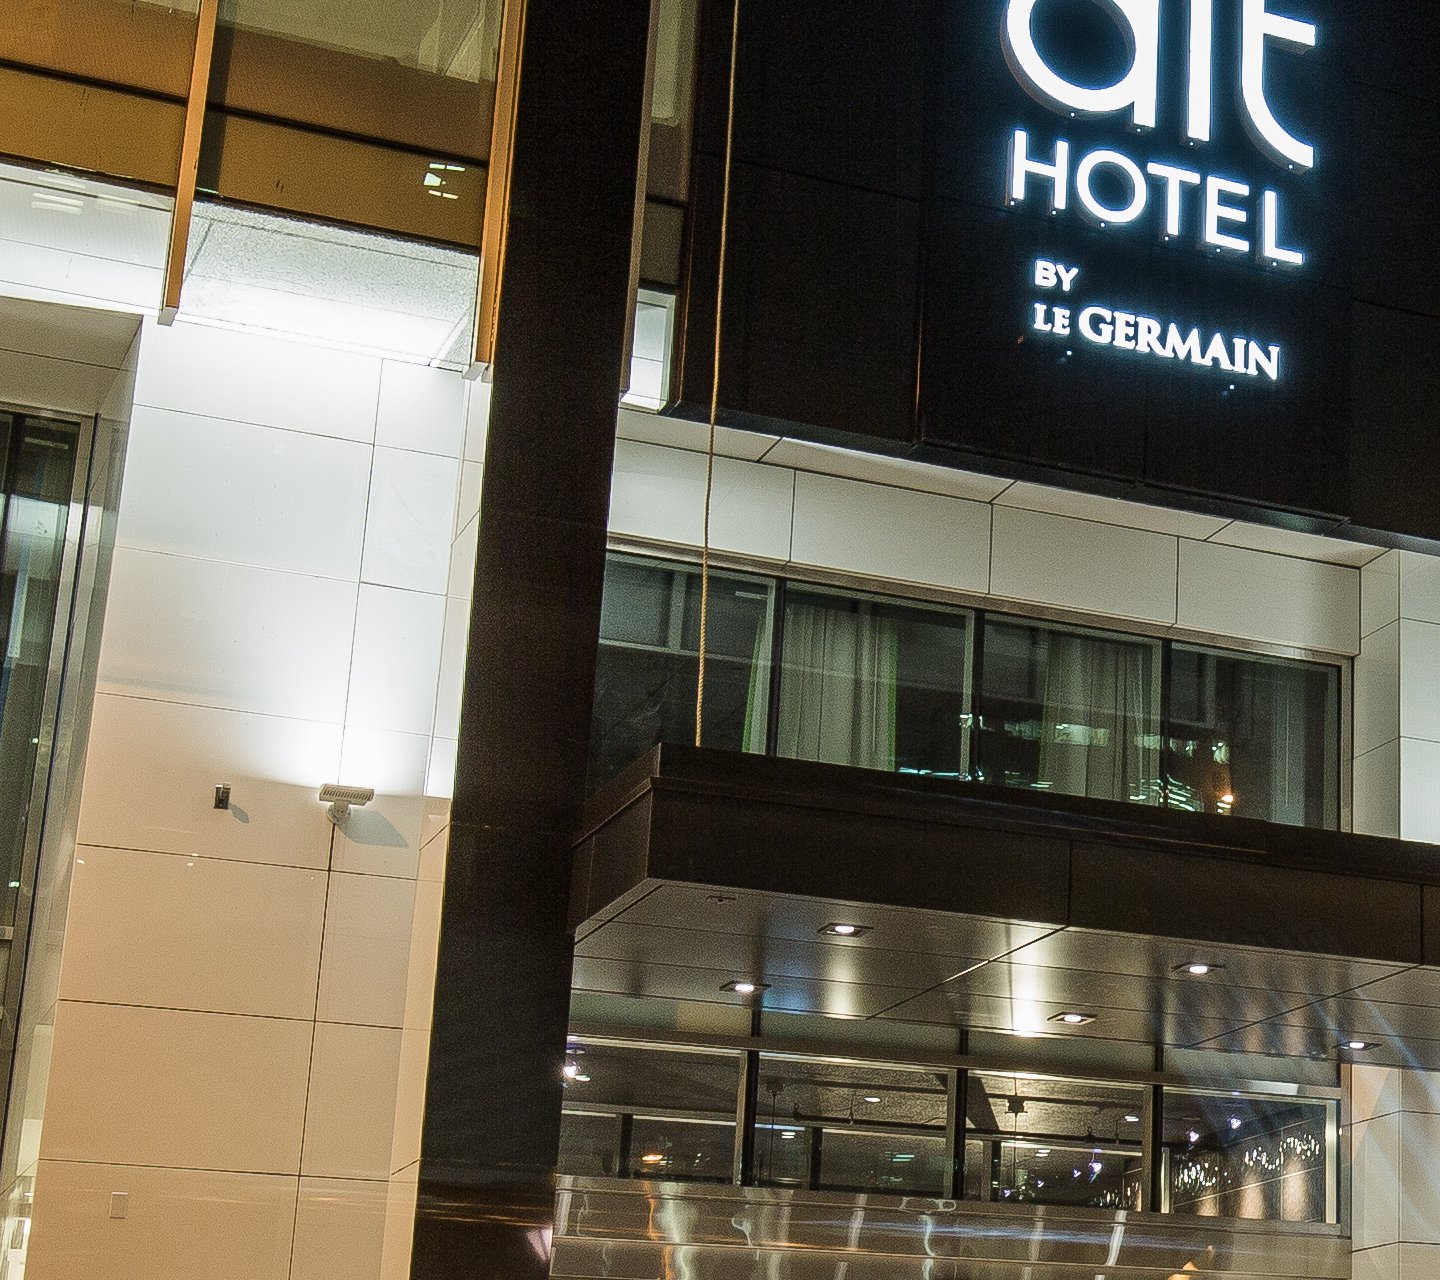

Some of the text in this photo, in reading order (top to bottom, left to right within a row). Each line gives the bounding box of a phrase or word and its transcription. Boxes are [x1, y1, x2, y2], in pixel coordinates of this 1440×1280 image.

[1012, 129, 1304, 266] HOTEL
[1034, 259, 1078, 291] BY
[1033, 302, 1280, 380] LE GERMAIN
